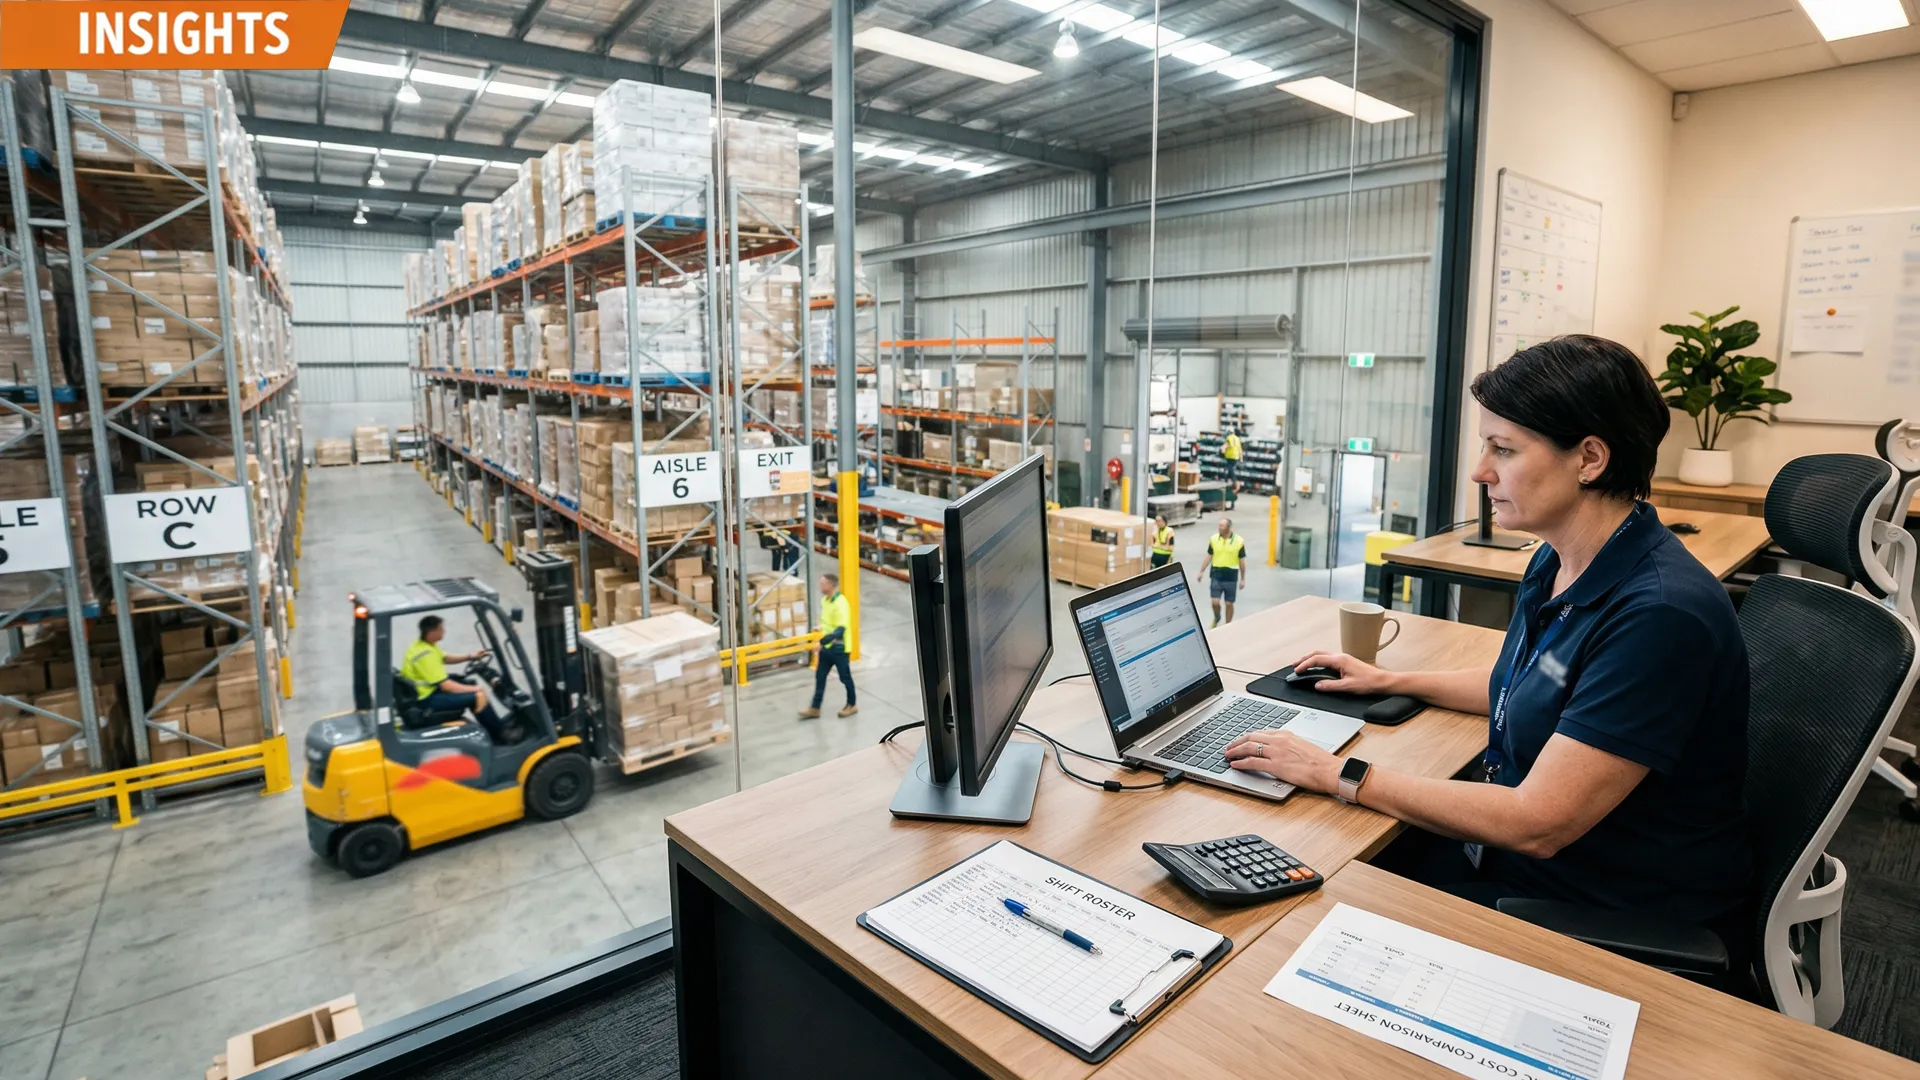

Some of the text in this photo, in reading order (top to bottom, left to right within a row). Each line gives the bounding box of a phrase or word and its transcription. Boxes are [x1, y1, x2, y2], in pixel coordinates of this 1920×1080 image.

[653, 456, 707, 474] AISLE
[757, 451, 794, 467] EXIT
[672, 477, 690, 498] 6
[137, 495, 217, 518] ROW
[163, 521, 197, 550] C
[1045, 876, 1084, 896] SHIFT
[1082, 893, 1136, 921] ROSTER
[1334, 1002, 1378, 1022] SHEET
[1380, 1019, 1475, 1060] COMPARISON
[1477, 1058, 1518, 1077] COST
